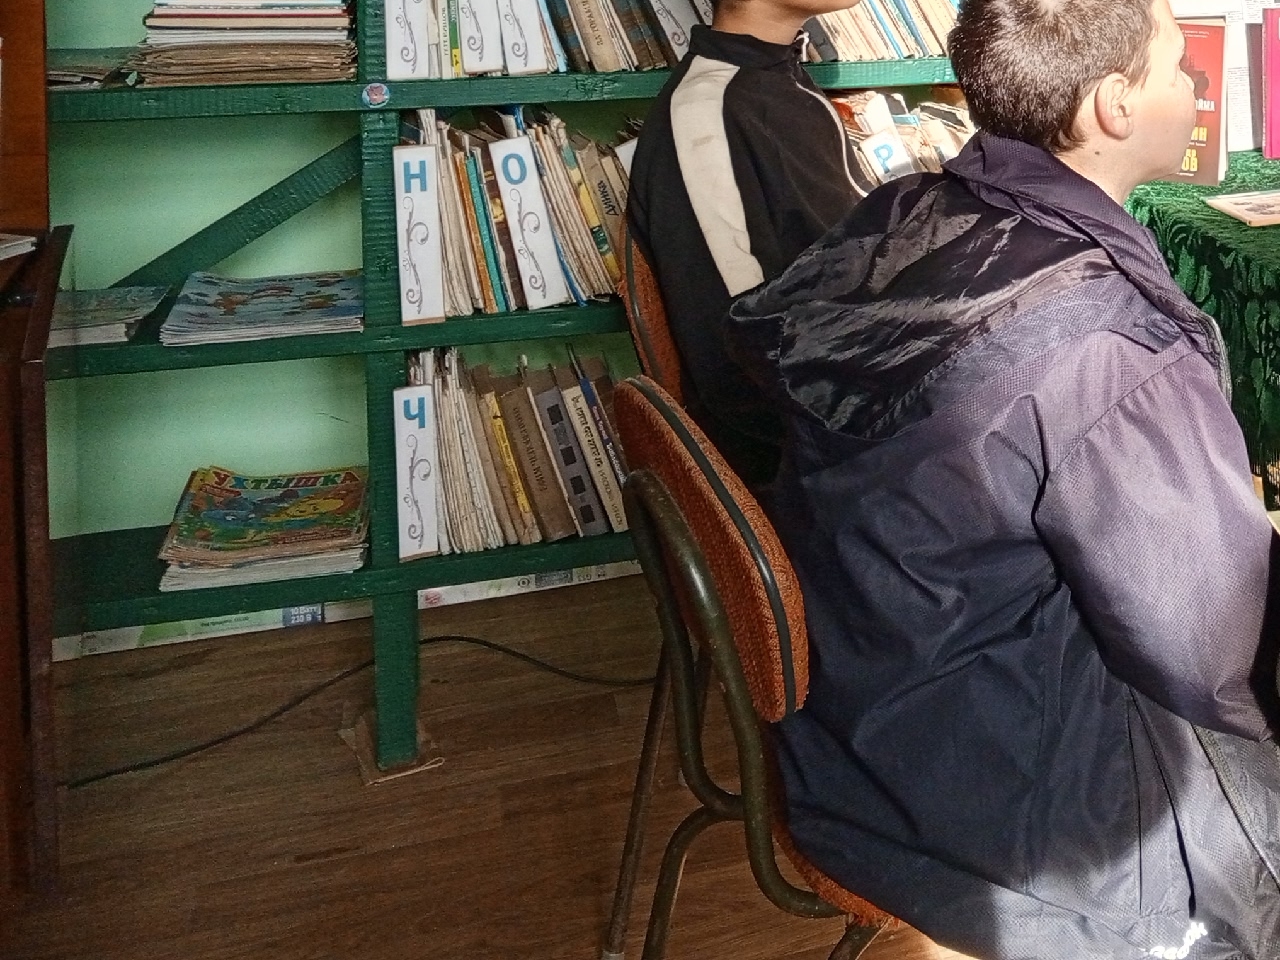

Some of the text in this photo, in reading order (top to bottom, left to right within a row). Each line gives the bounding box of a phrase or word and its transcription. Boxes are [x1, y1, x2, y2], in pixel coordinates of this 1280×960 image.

[502, 153, 527, 185] О
[873, 143, 893, 173] Р
[403, 160, 427, 193] Н
[403, 396, 426, 429] Ч
[210, 470, 362, 492] УХТЫШКА
